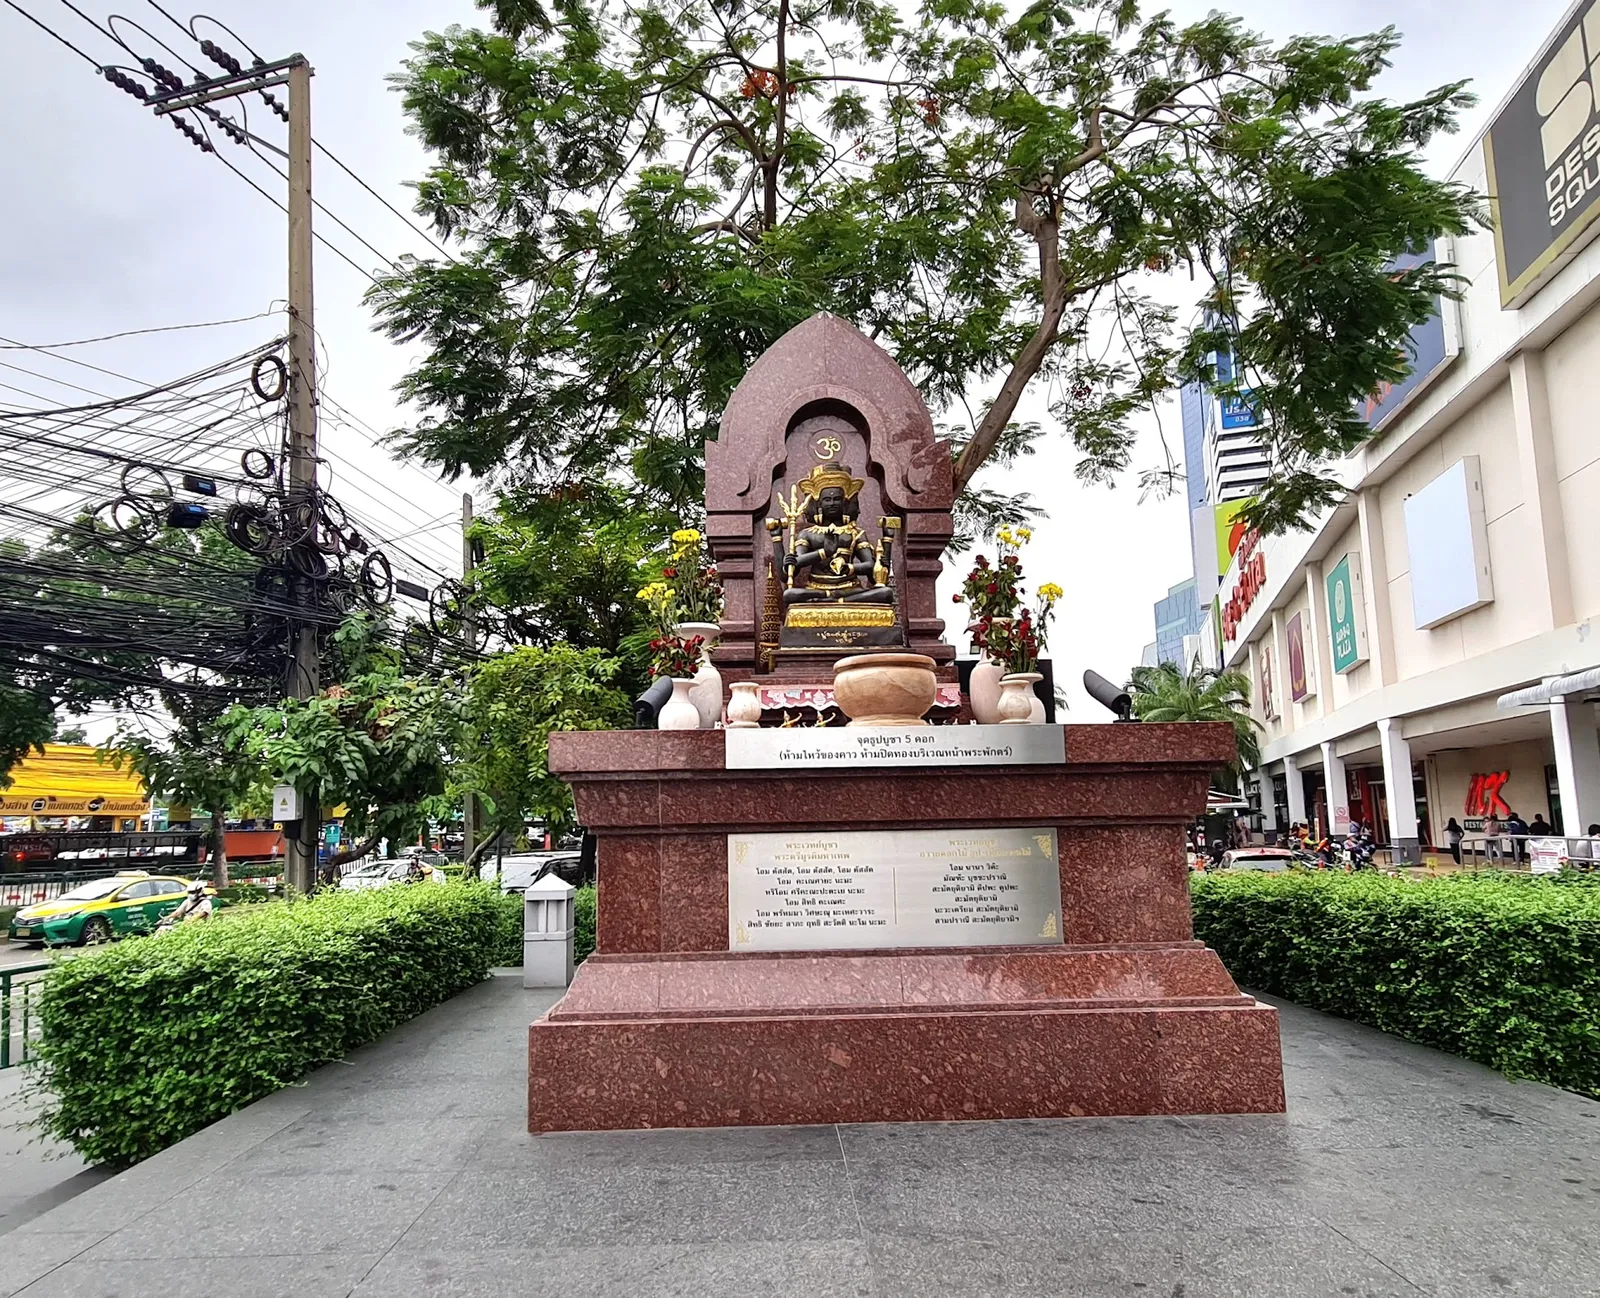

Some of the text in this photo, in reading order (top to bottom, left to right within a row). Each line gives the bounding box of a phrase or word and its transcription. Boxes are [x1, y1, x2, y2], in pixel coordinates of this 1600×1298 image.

[905, 734, 912, 744] 5
[914, 735, 935, 744] ดอก
[1464, 770, 1511, 817] MK
